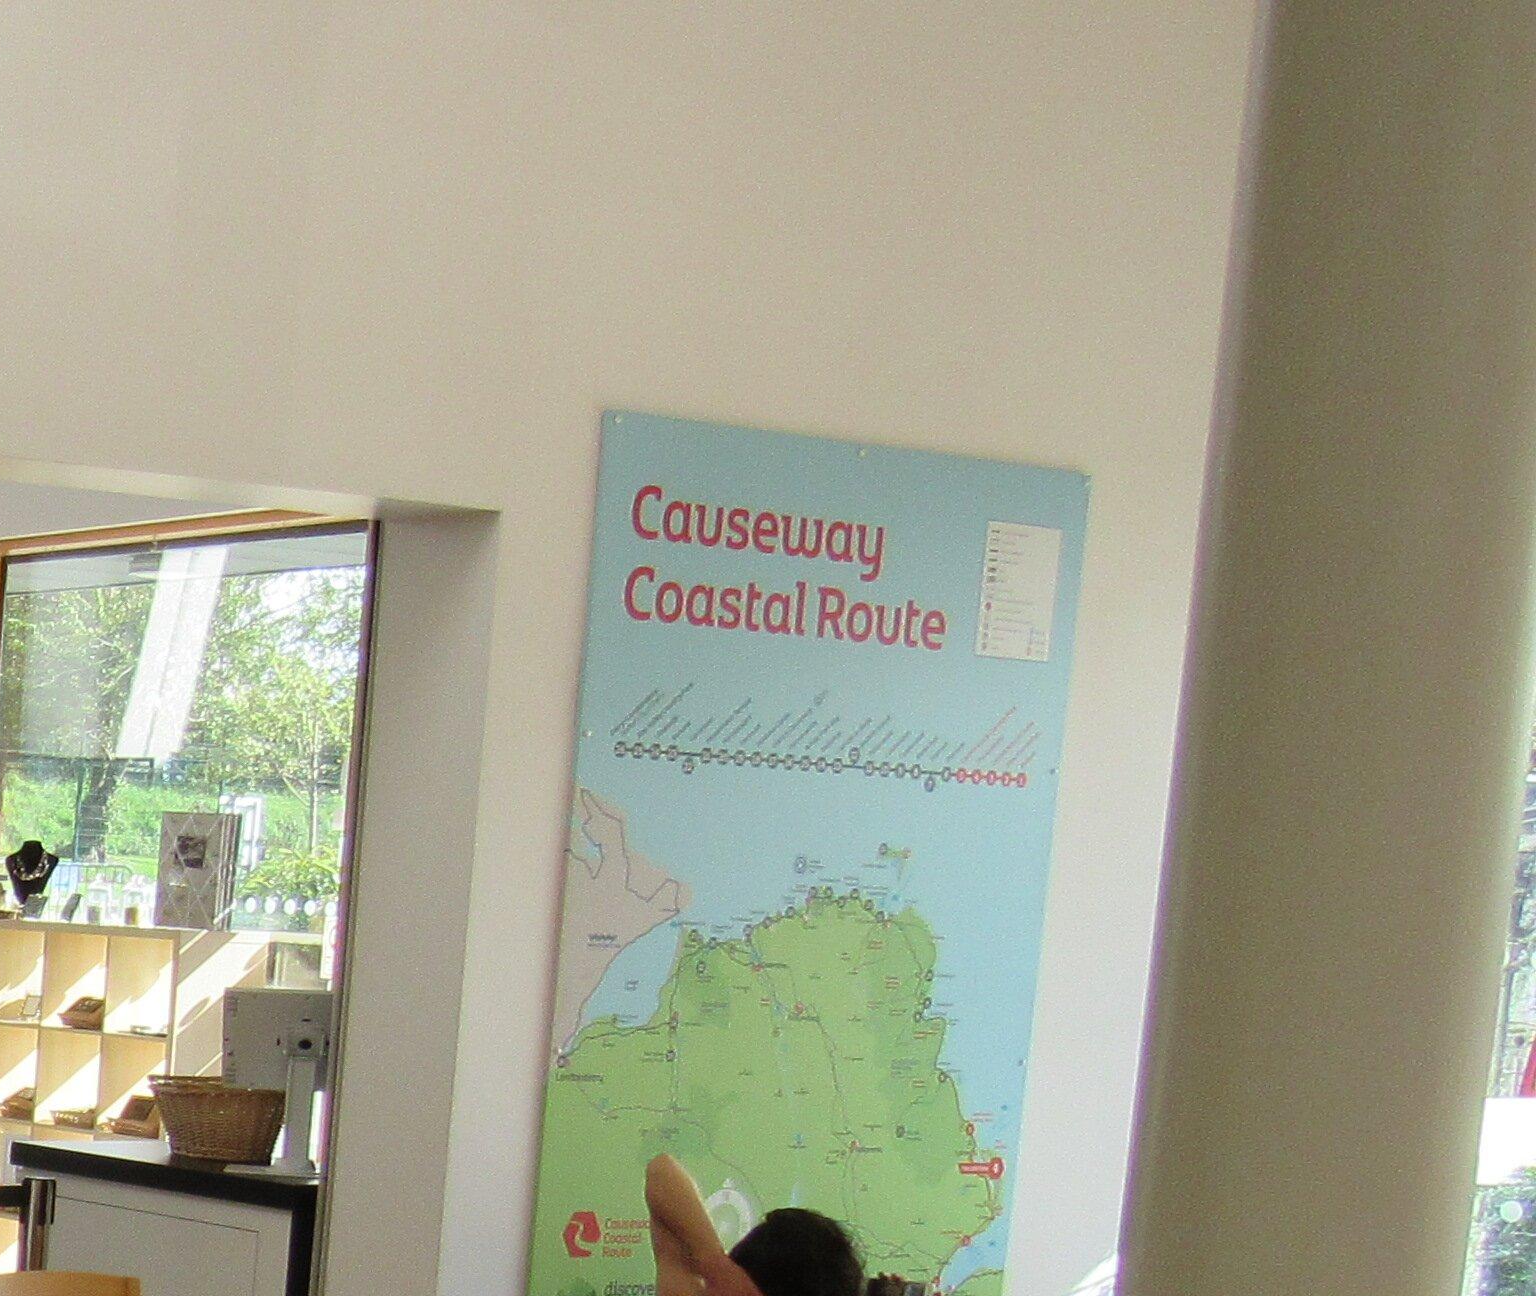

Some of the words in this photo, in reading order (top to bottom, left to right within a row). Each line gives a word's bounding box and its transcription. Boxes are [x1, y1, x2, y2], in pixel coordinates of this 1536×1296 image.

[631, 484, 885, 583] Causeway
[624, 565, 806, 637] Coastal
[817, 586, 947, 651] Route
[605, 1218, 650, 1229] Causewa
[603, 1280, 656, 1296] discove
